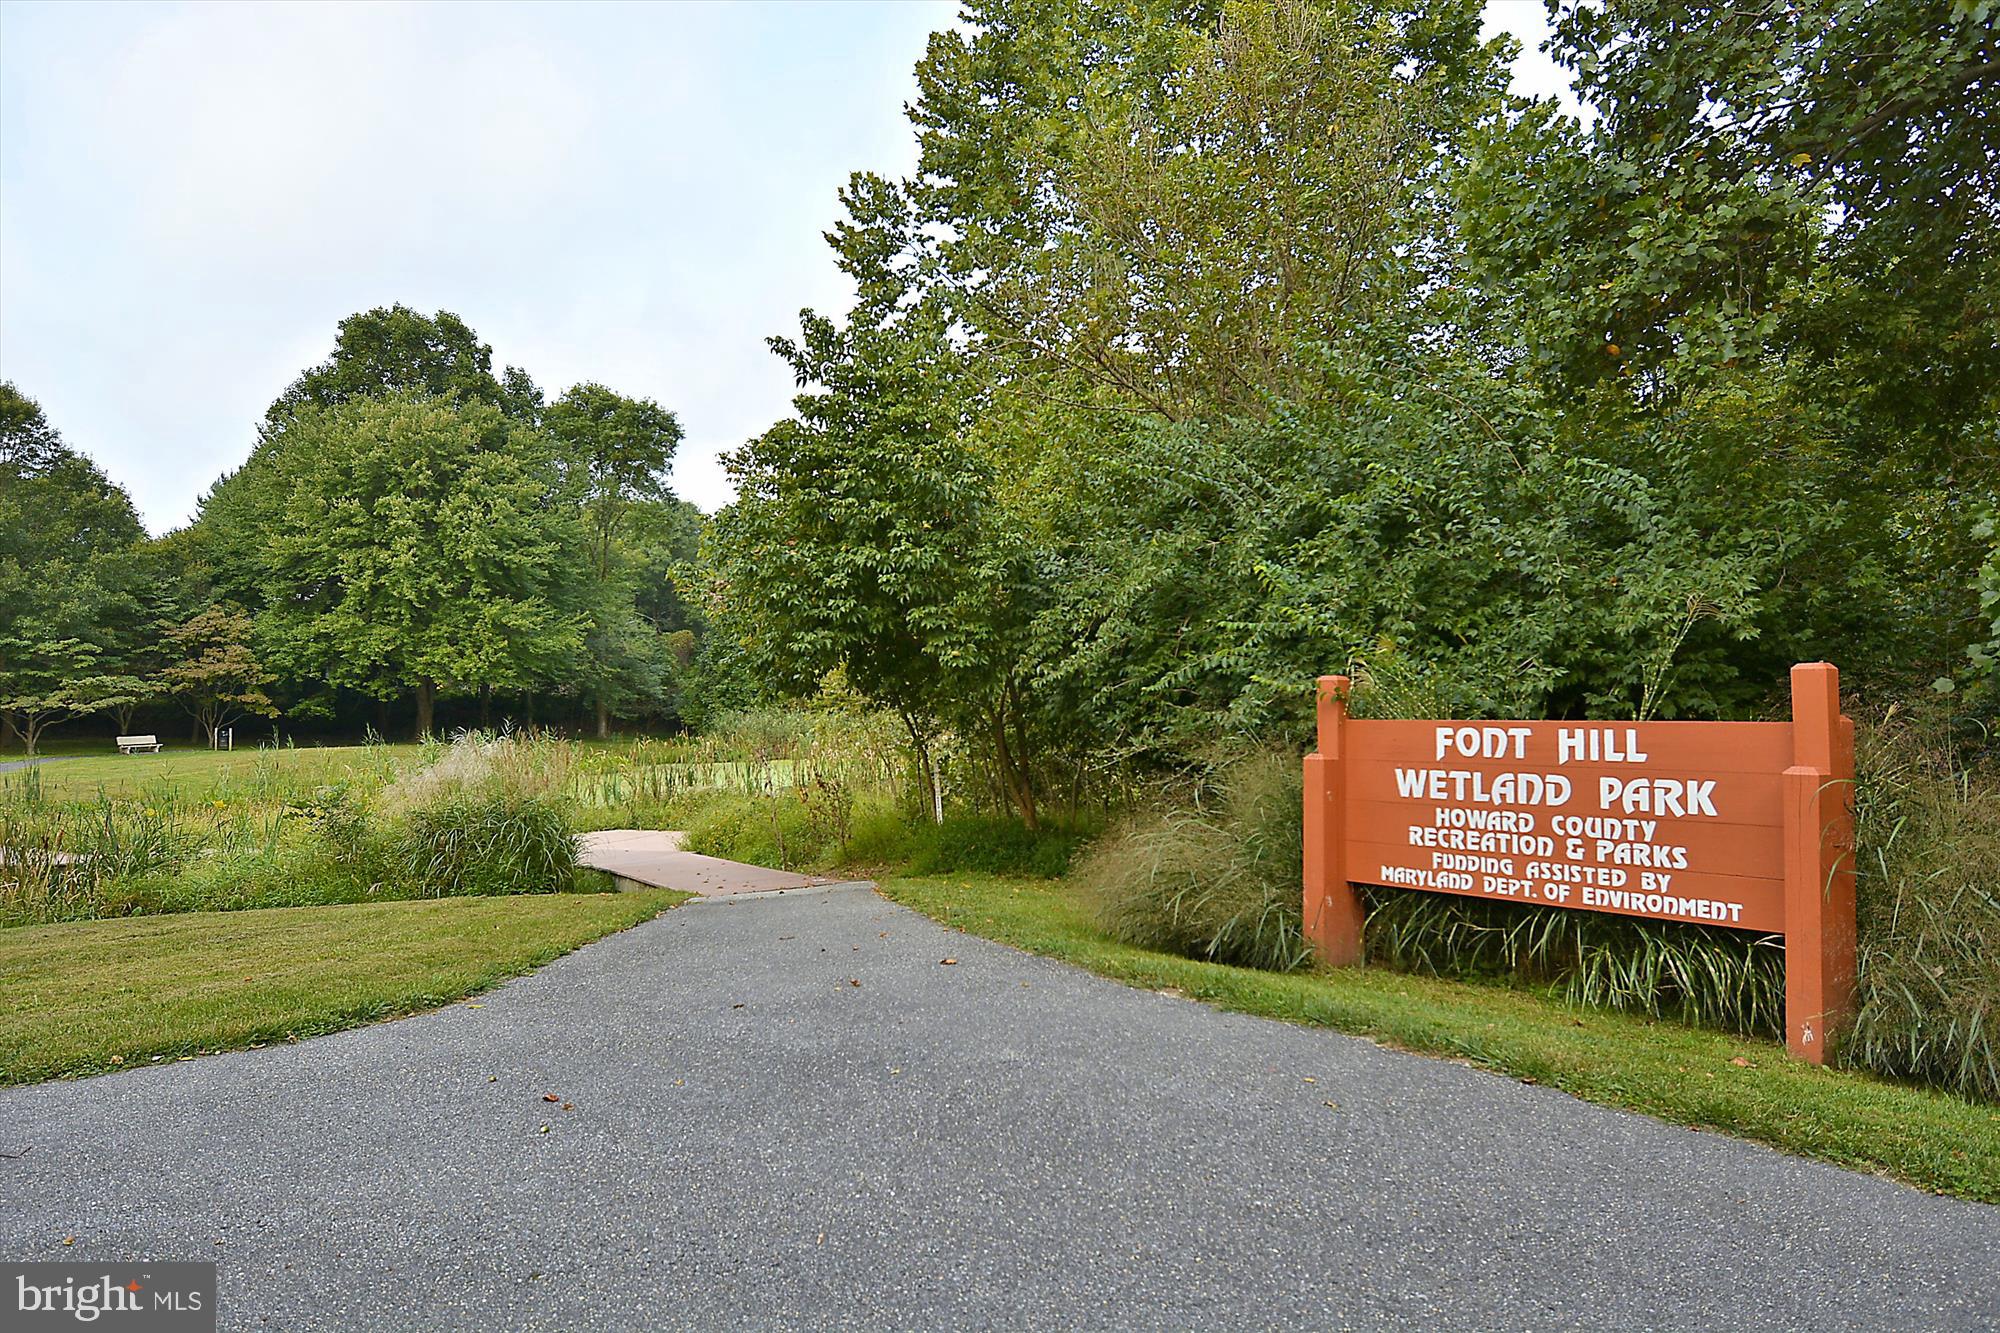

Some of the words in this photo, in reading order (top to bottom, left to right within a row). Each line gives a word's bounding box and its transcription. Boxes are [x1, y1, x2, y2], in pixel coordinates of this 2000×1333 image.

[1436, 728, 1532, 761] FONT
[1558, 729, 1647, 764] HILL
[1395, 769, 1571, 805] WETLAND
[1600, 777, 1718, 817] PARK
[1436, 808, 1534, 832] HOWARD
[1552, 816, 1656, 842] COUNTY
[1409, 826, 1553, 856] RECREATION
[1566, 838, 1585, 860] &
[1596, 840, 1687, 869] PARKS
[1381, 866, 1473, 890] MARYLAND
[1483, 876, 1537, 898] DEPT.
[1544, 883, 1570, 902] OF
[1583, 887, 1743, 921] ENVIRONMENT
[1433, 852, 1513, 875] FUNDING
[1526, 862, 1627, 886] ASSISTED
[1641, 872, 1671, 893] BY
